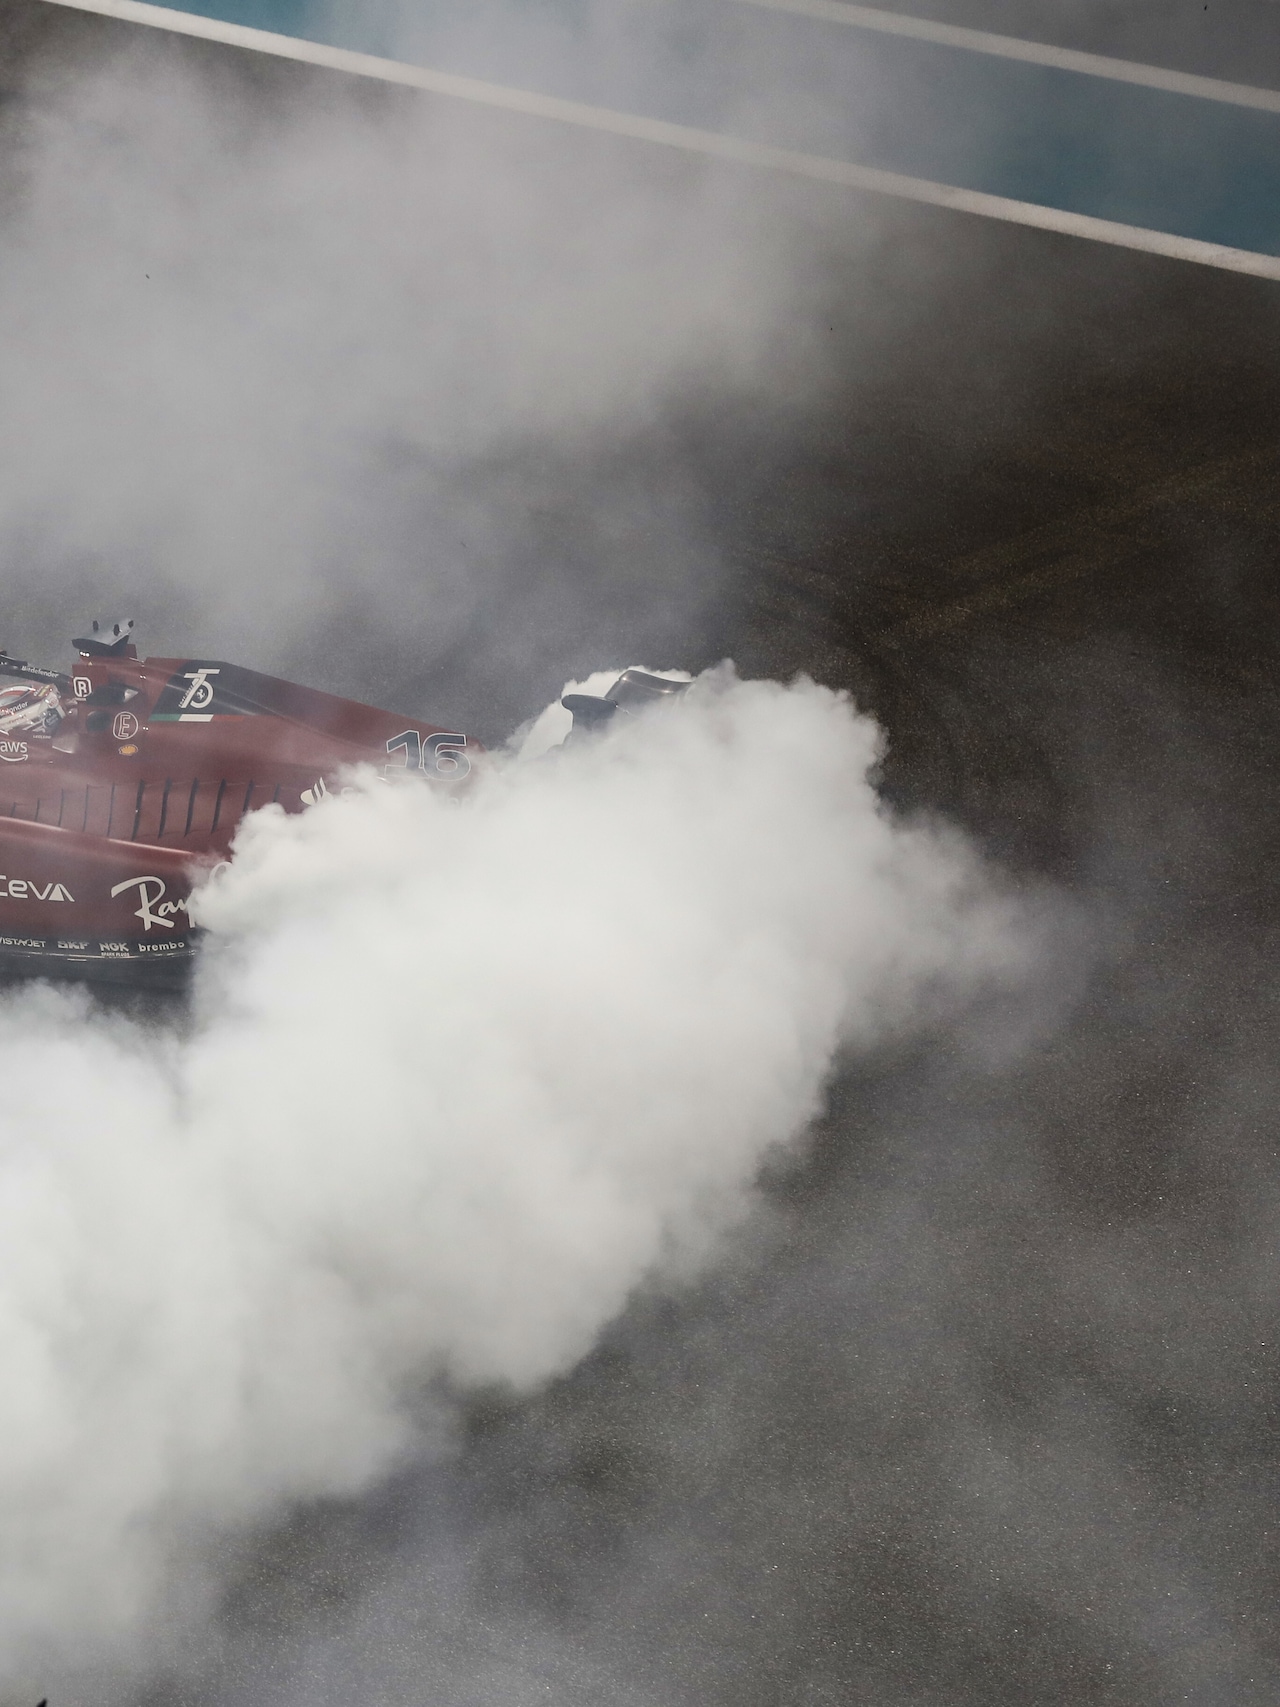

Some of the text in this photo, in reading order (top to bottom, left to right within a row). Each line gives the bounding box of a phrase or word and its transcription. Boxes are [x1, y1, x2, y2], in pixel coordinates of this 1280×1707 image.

[0, 741, 28, 753] aws
[384, 730, 471, 781] 16
[99, 942, 130, 952] NGK
[138, 941, 185, 952] brembo
